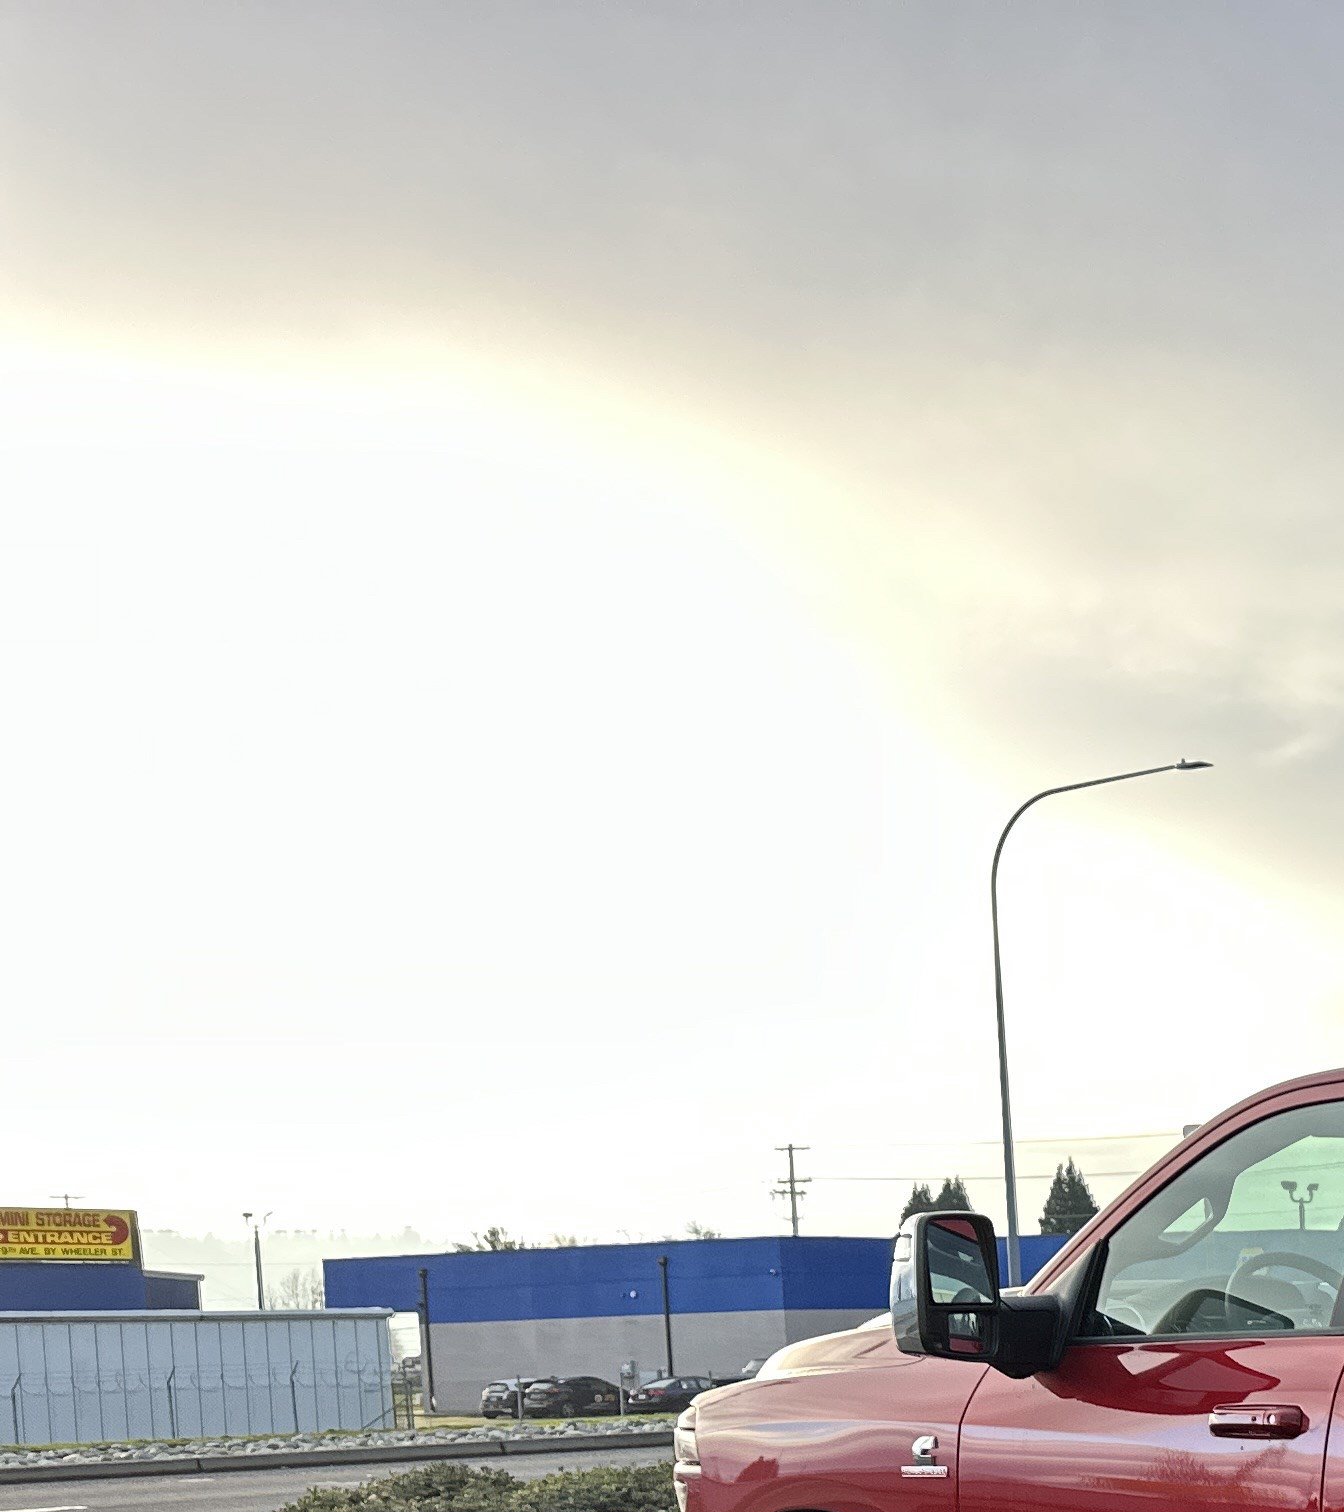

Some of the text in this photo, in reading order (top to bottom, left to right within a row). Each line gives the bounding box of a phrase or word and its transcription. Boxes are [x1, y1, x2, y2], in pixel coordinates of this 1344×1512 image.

[35, 1212, 101, 1227] STORAGE
[7, 1231, 113, 1243] ENTRANCE
[61, 1248, 107, 1256] WHEELER
